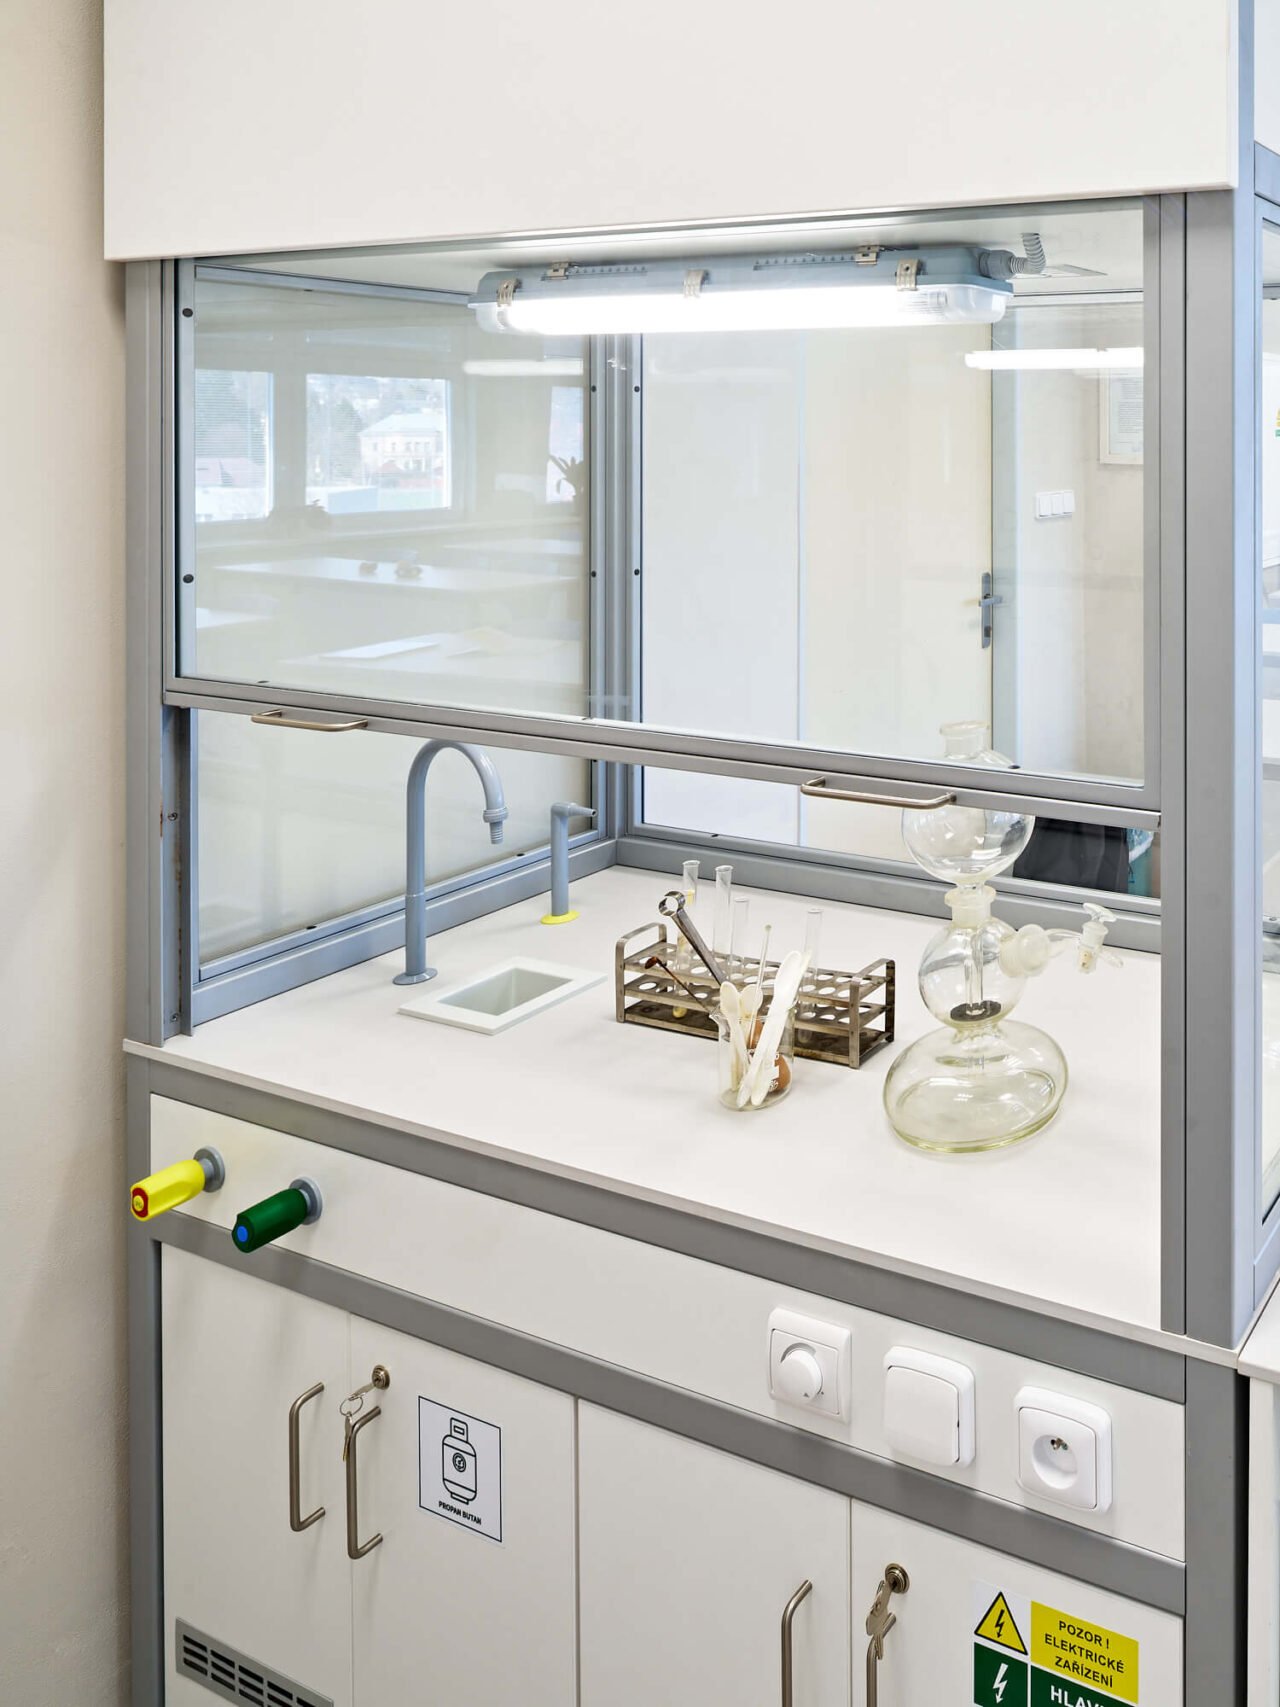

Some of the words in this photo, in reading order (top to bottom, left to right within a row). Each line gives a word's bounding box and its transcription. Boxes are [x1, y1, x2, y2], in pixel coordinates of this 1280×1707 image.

[439, 1500, 461, 1516] PROPAN
[462, 1511, 481, 1525] BUTAN
[1058, 1620, 1103, 1647] POZOR
[1044, 1632, 1124, 1674] ELEKTRICKÉ
[1055, 1655, 1113, 1688] ZAŘÍZENÍ
[1050, 1685, 1104, 1707] HLA
